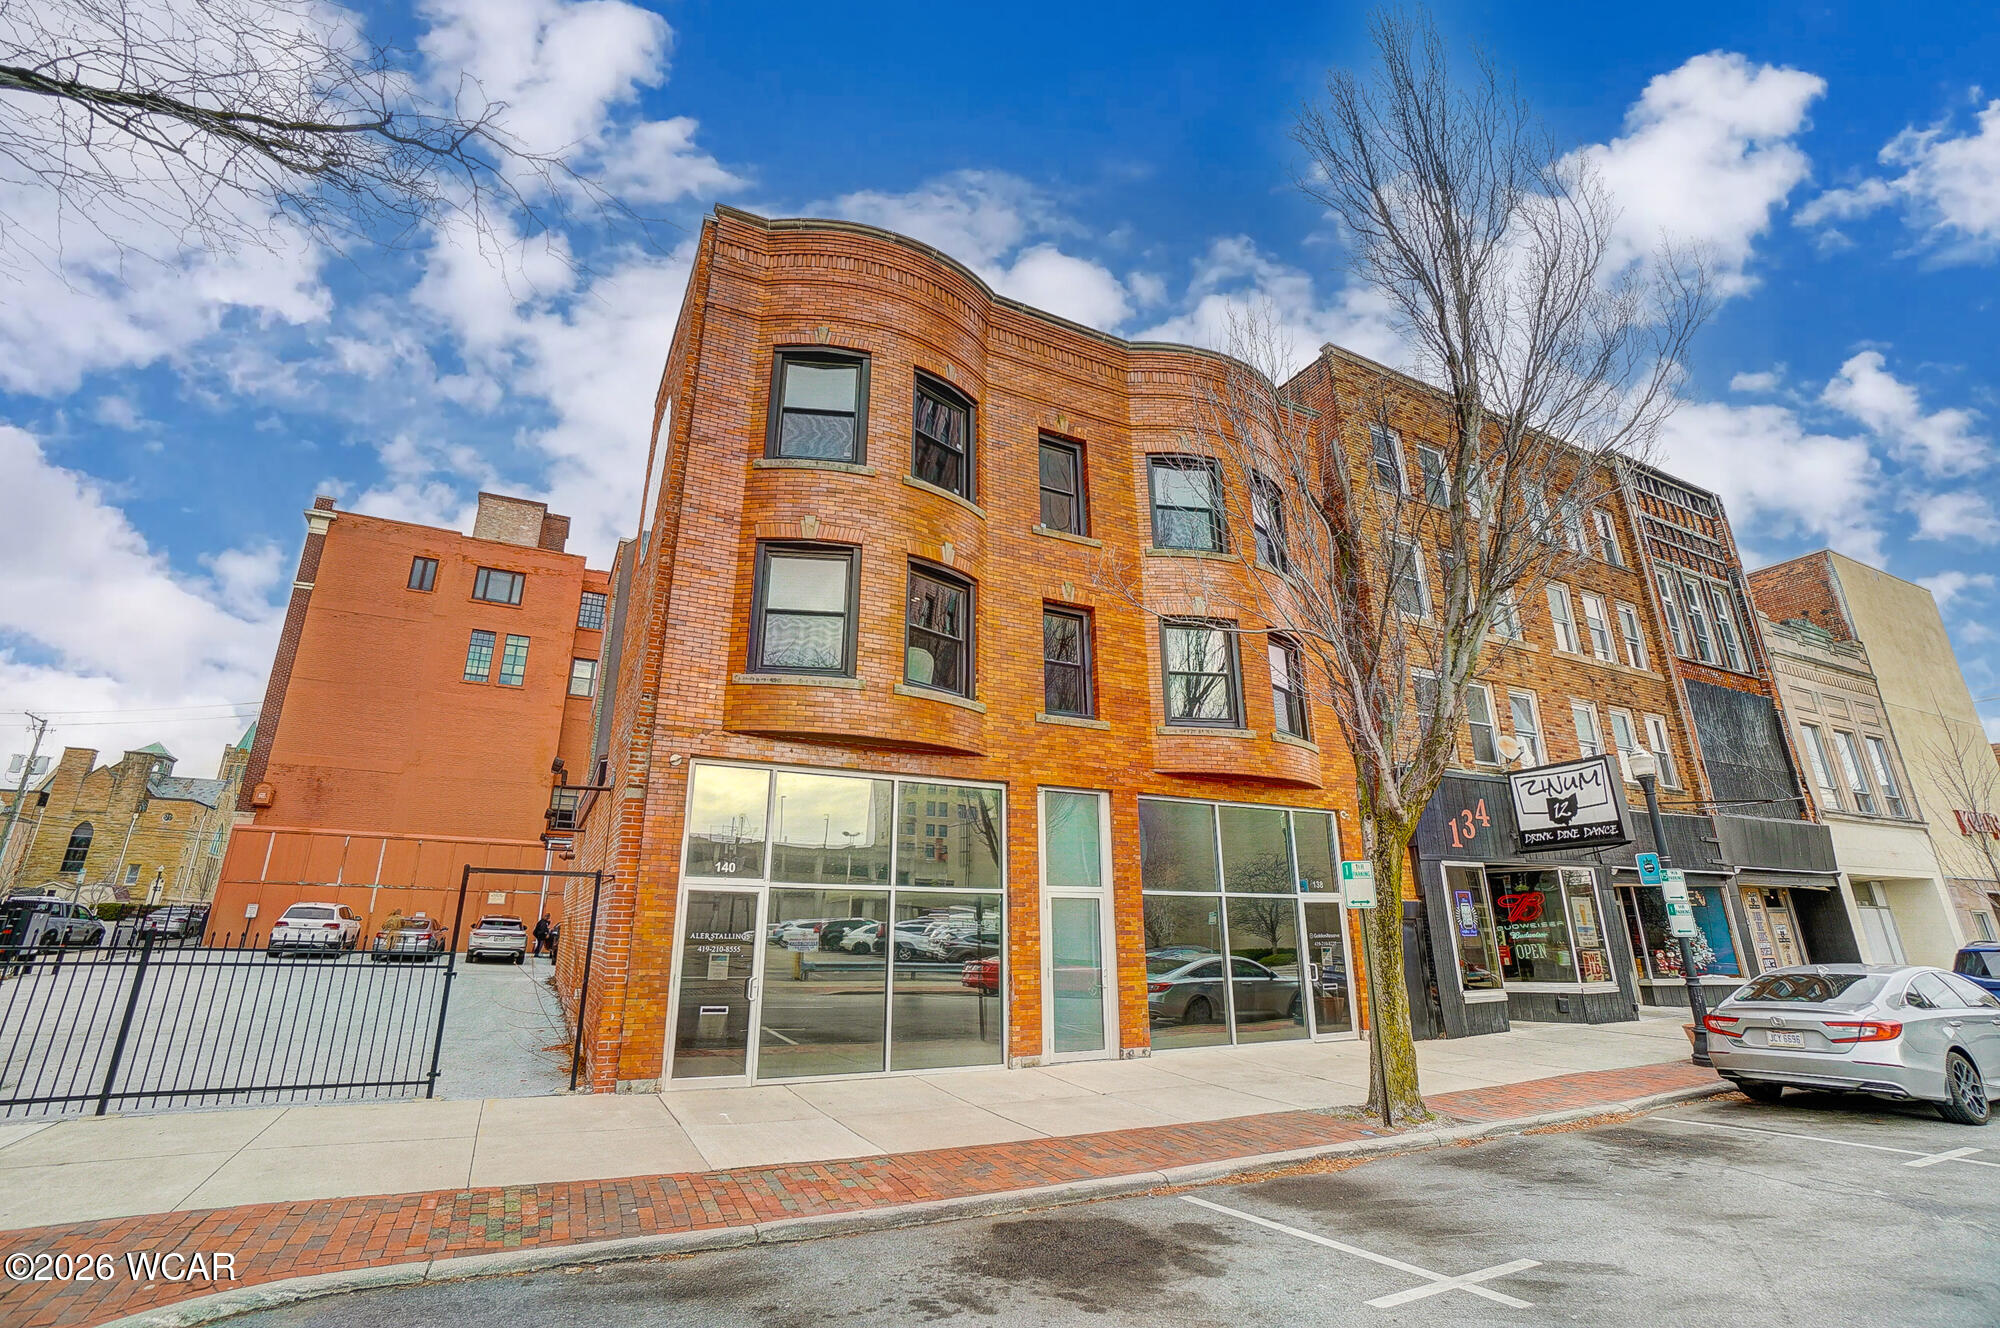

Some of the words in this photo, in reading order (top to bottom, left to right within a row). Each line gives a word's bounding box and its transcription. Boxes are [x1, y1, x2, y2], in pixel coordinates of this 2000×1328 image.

[1553, 801, 1572, 819] 12
[1448, 798, 1491, 848] 134
[1524, 832, 1554, 844] DRINK
[1557, 829, 1580, 840] DINE
[1583, 824, 1619, 838] DANCE
[714, 861, 736, 873] 140
[1312, 881, 1324, 889] 138
[1515, 943, 1548, 960] OPEN
